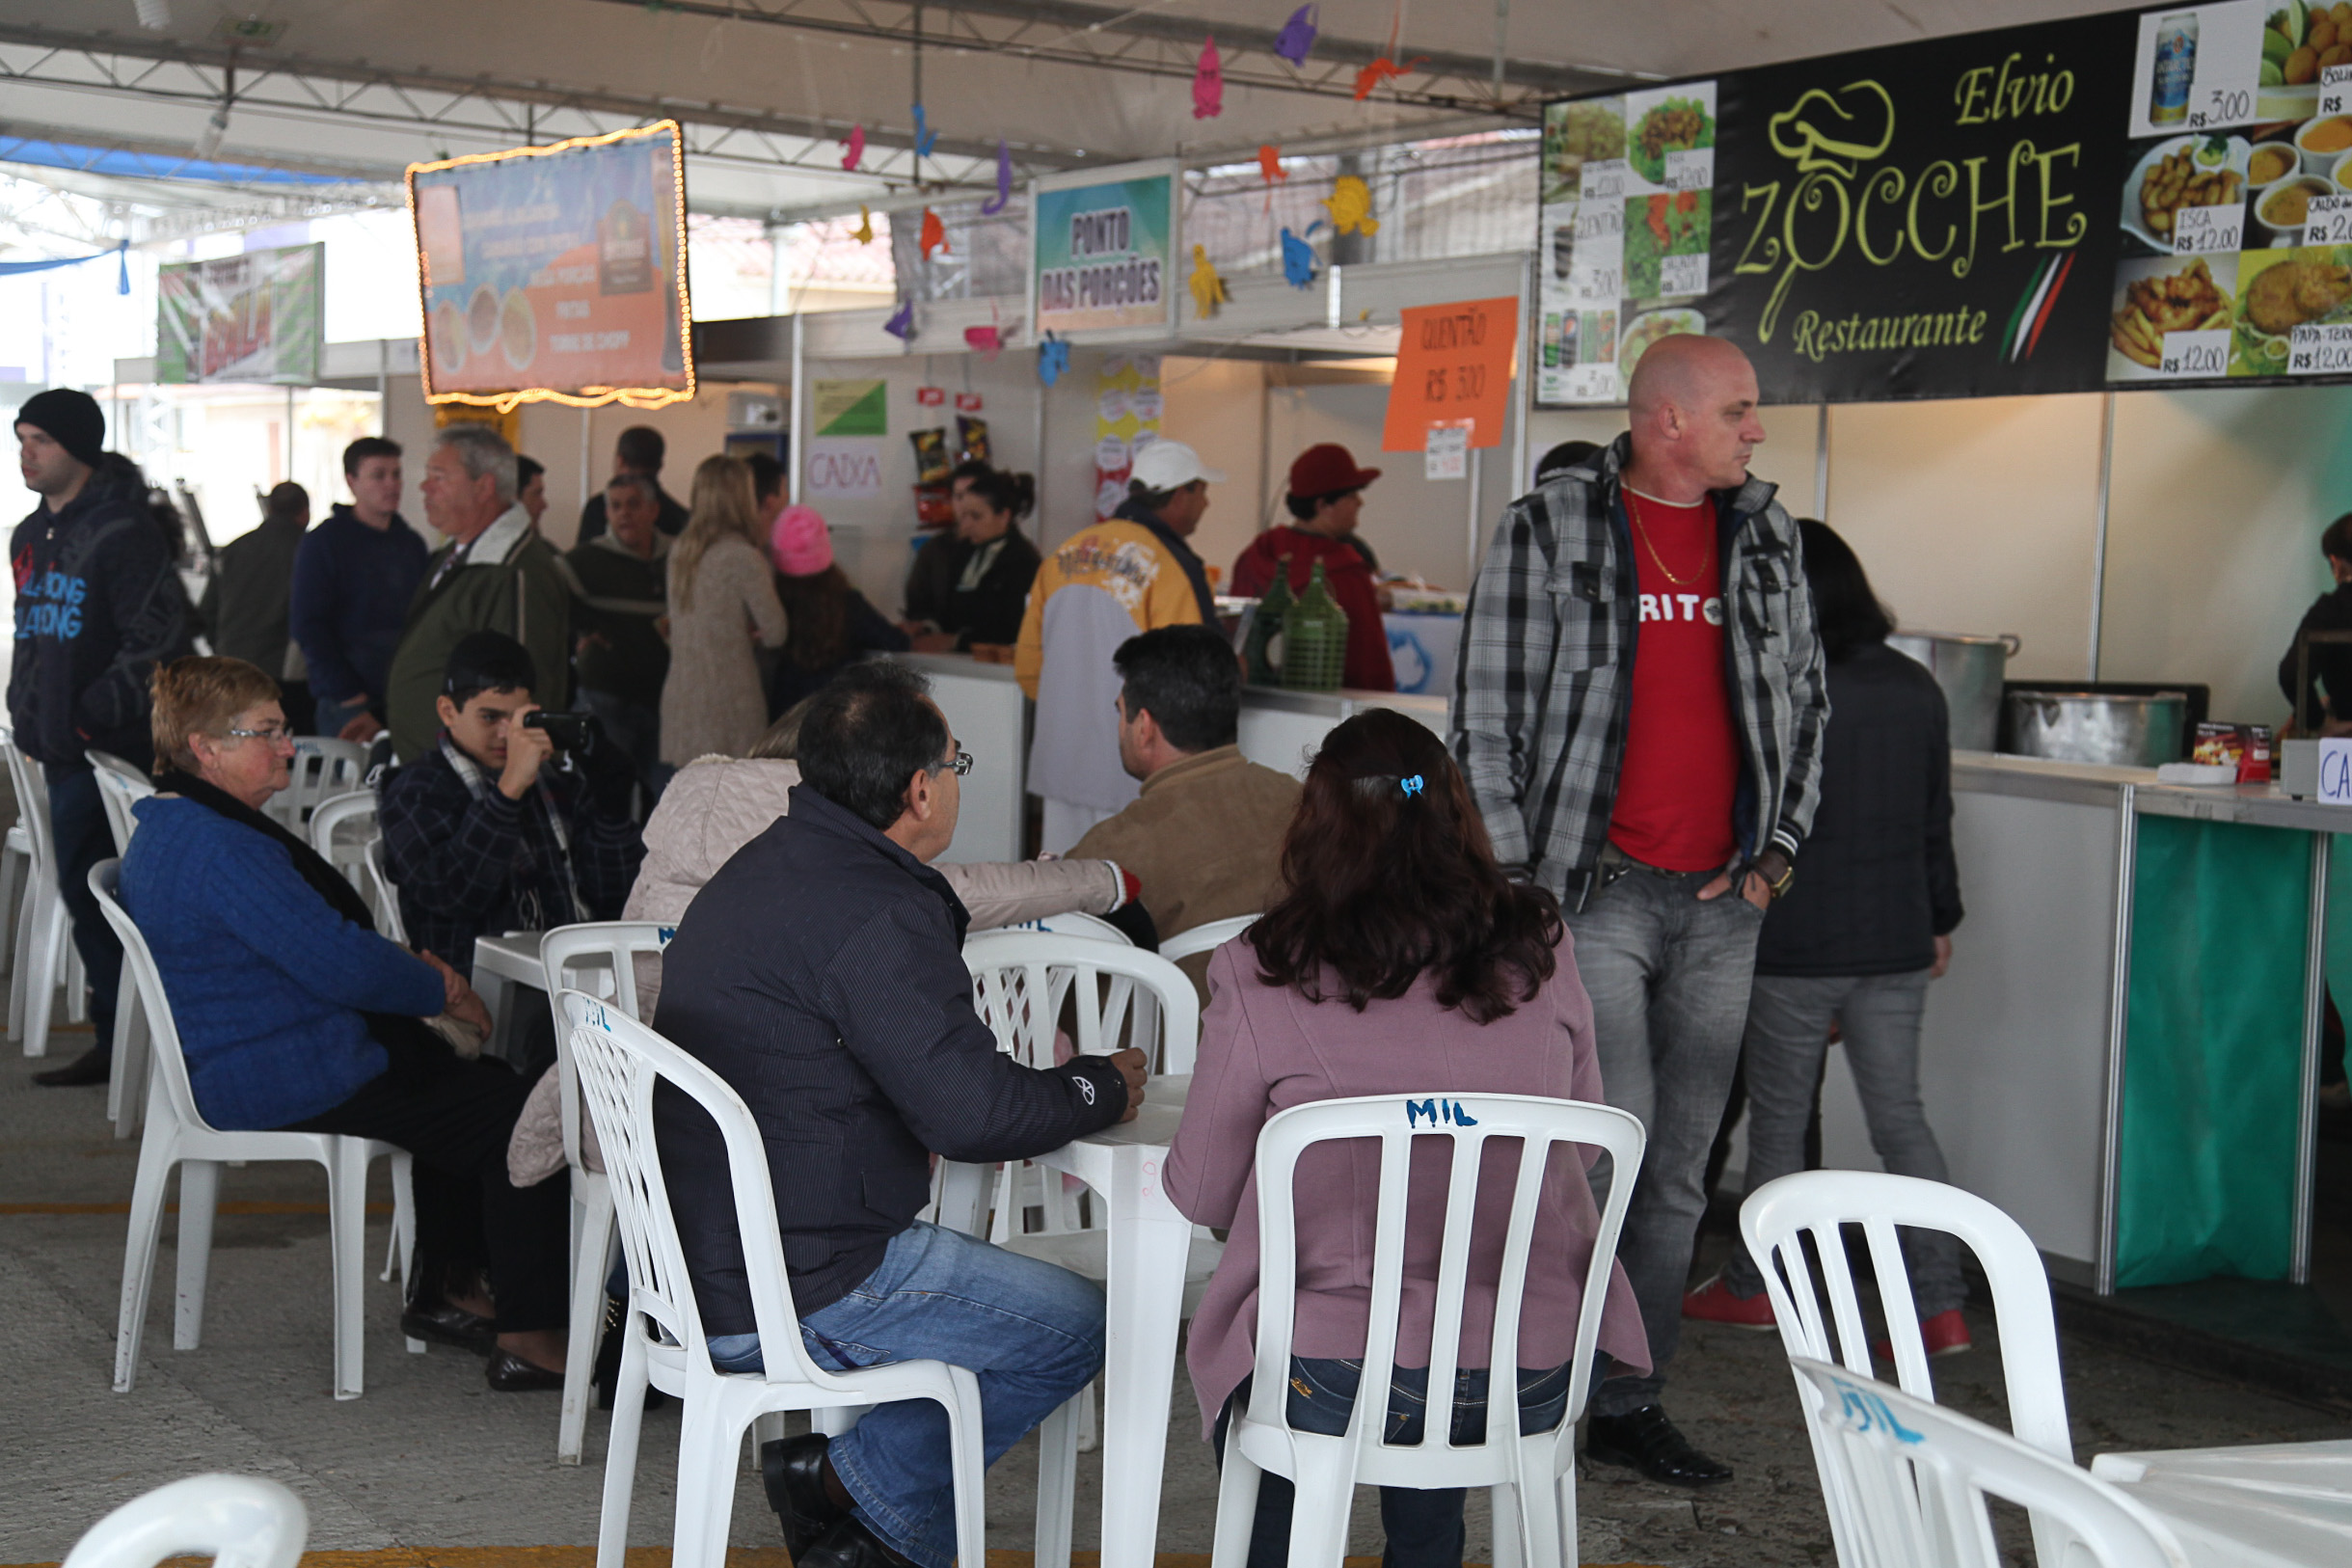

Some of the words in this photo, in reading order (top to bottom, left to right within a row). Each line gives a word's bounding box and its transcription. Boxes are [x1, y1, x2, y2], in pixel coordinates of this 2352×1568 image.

[1955, 52, 2074, 125] Elvio
[2322, 95, 2342, 113] R$
[1733, 139, 2087, 279] ZOCCHE
[2179, 209, 2211, 230] ISCA
[1071, 207, 1130, 259] PONTO
[2176, 235, 2194, 252] R$
[2309, 226, 2328, 242] R$
[1794, 305, 1988, 363] Restaurante
[2293, 352, 2311, 368] R$
[806, 452, 881, 490] CAIXA
[1406, 1097, 1478, 1128] MIL
